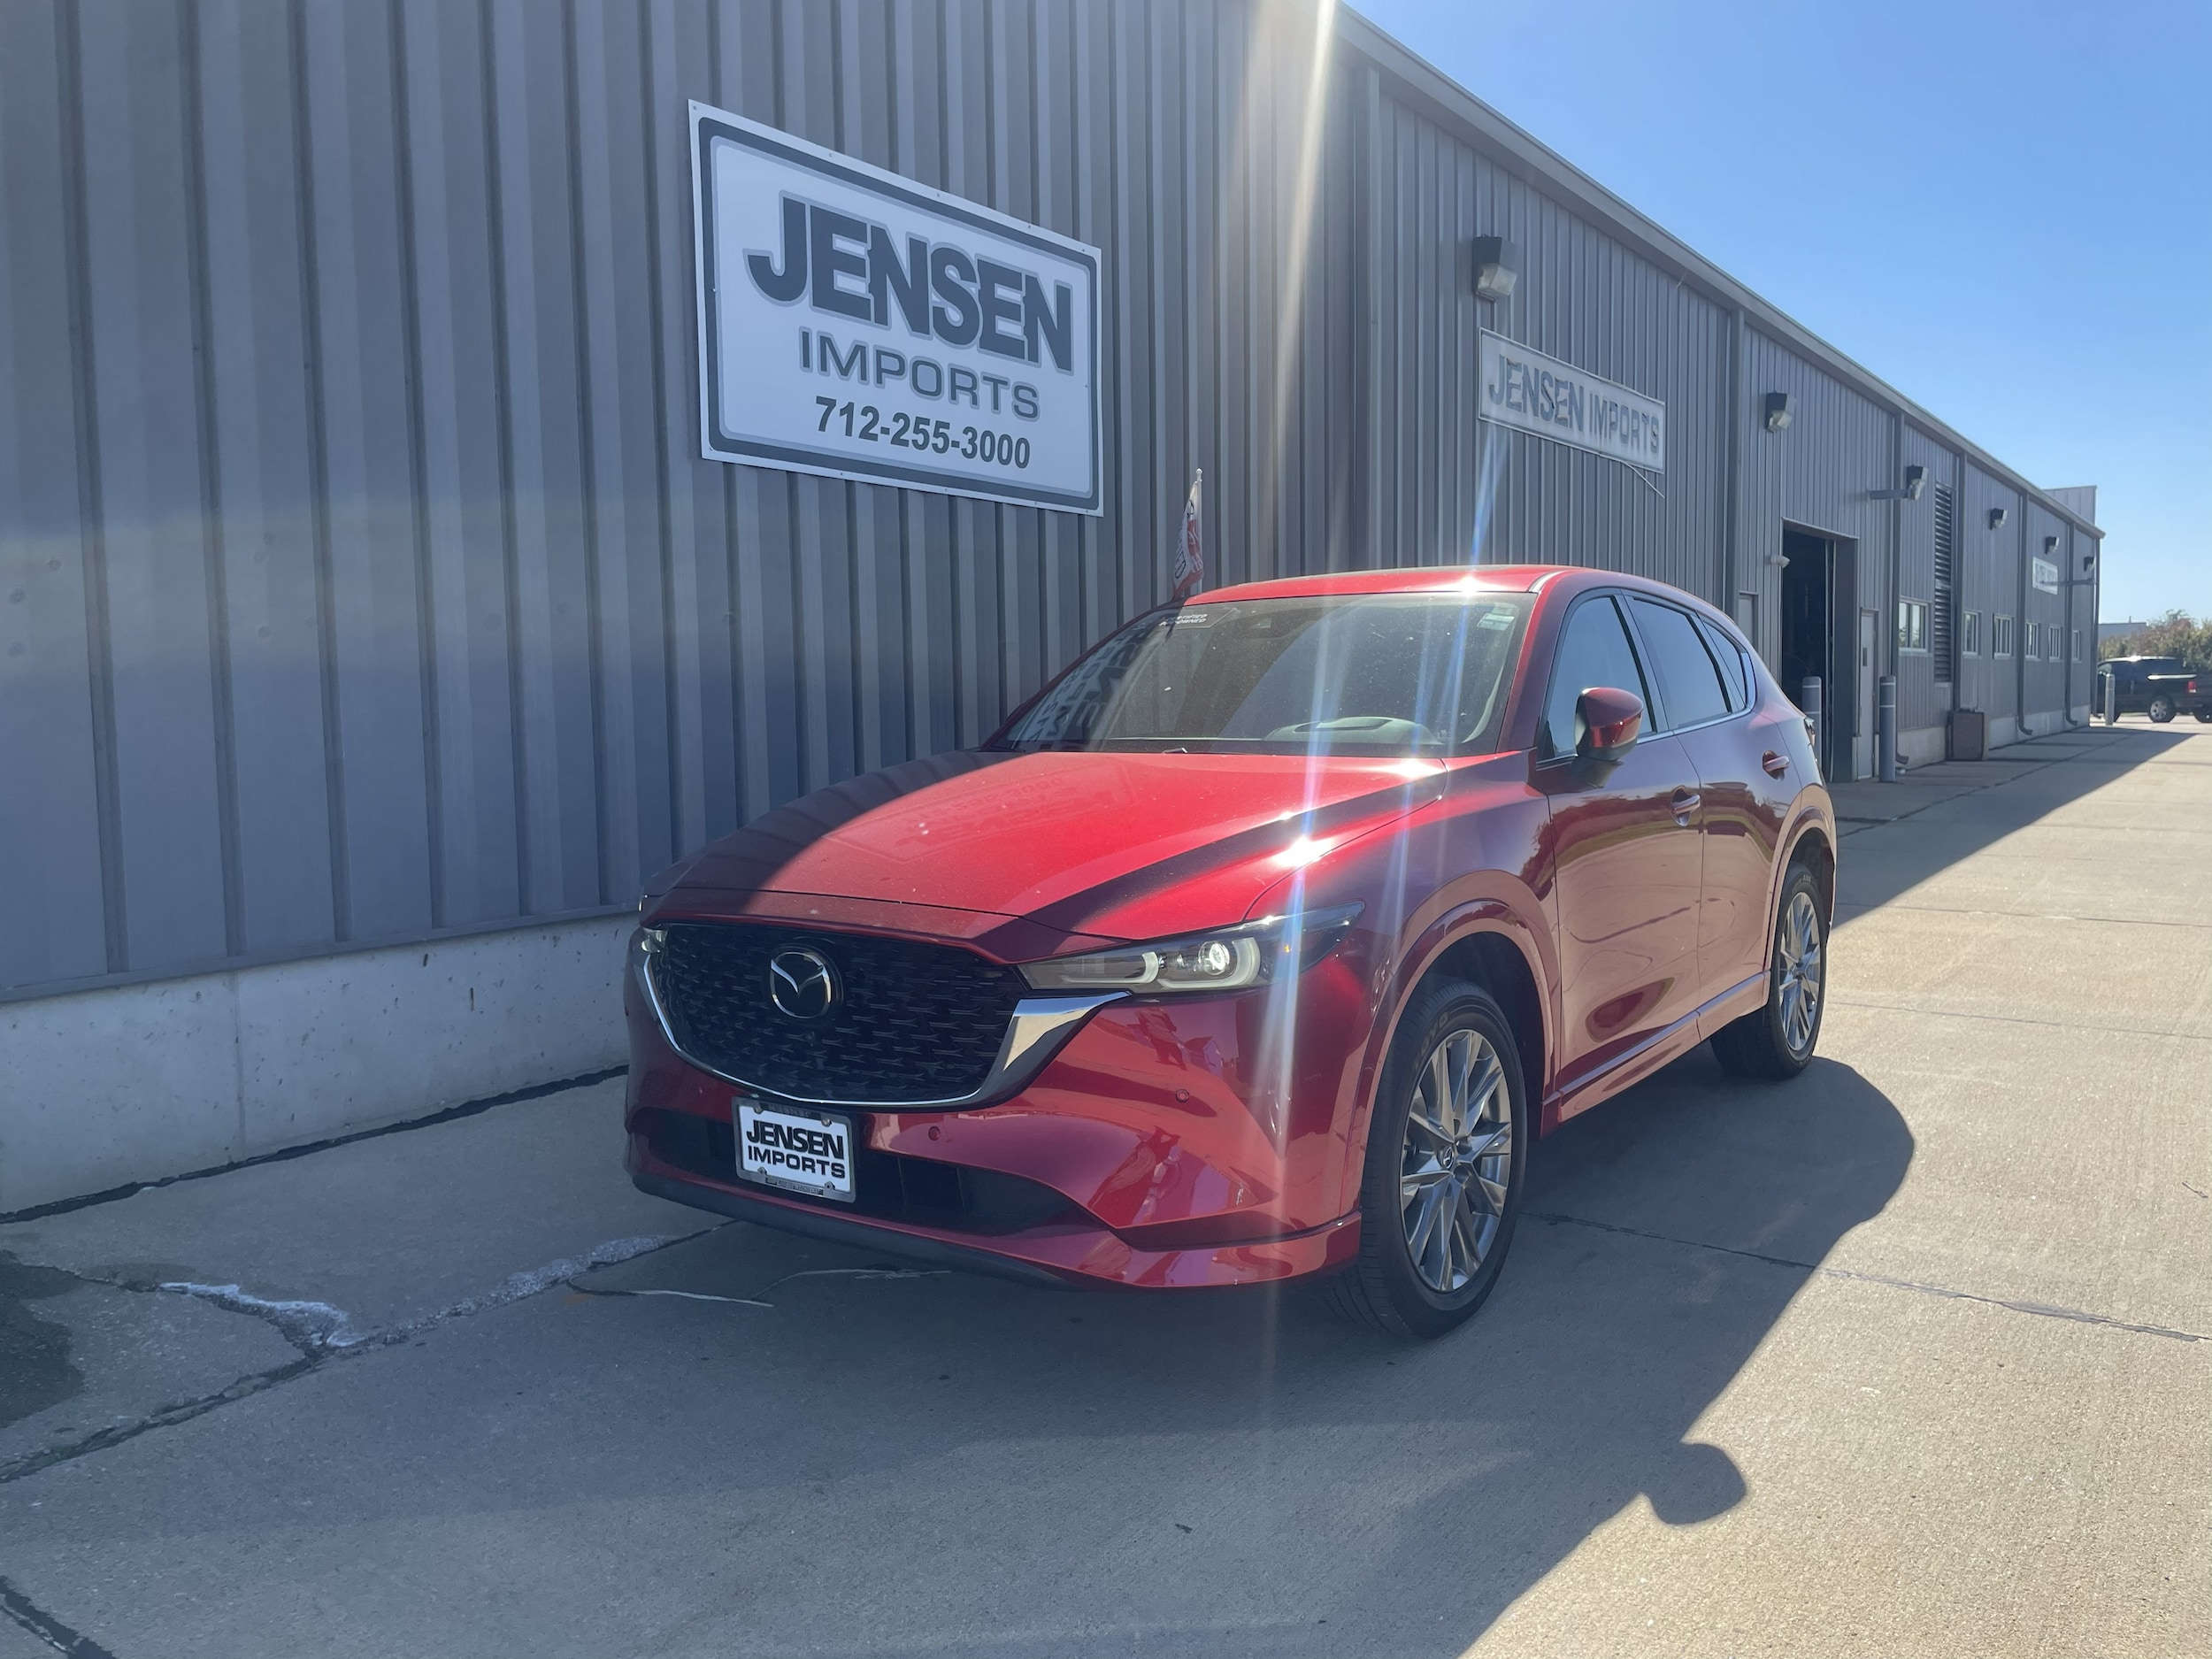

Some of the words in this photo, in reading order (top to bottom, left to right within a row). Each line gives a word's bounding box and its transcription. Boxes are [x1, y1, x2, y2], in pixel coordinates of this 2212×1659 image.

[745, 194, 1073, 373] JENSEN
[801, 329, 1040, 420] IMPORTS
[1488, 353, 1585, 433] JENSEN
[1589, 393, 1661, 454] IMPORTS
[814, 396, 1031, 469] 712-255-3000
[746, 1119, 845, 1160] JENSEN
[748, 1145, 846, 1179] IMPORTS
